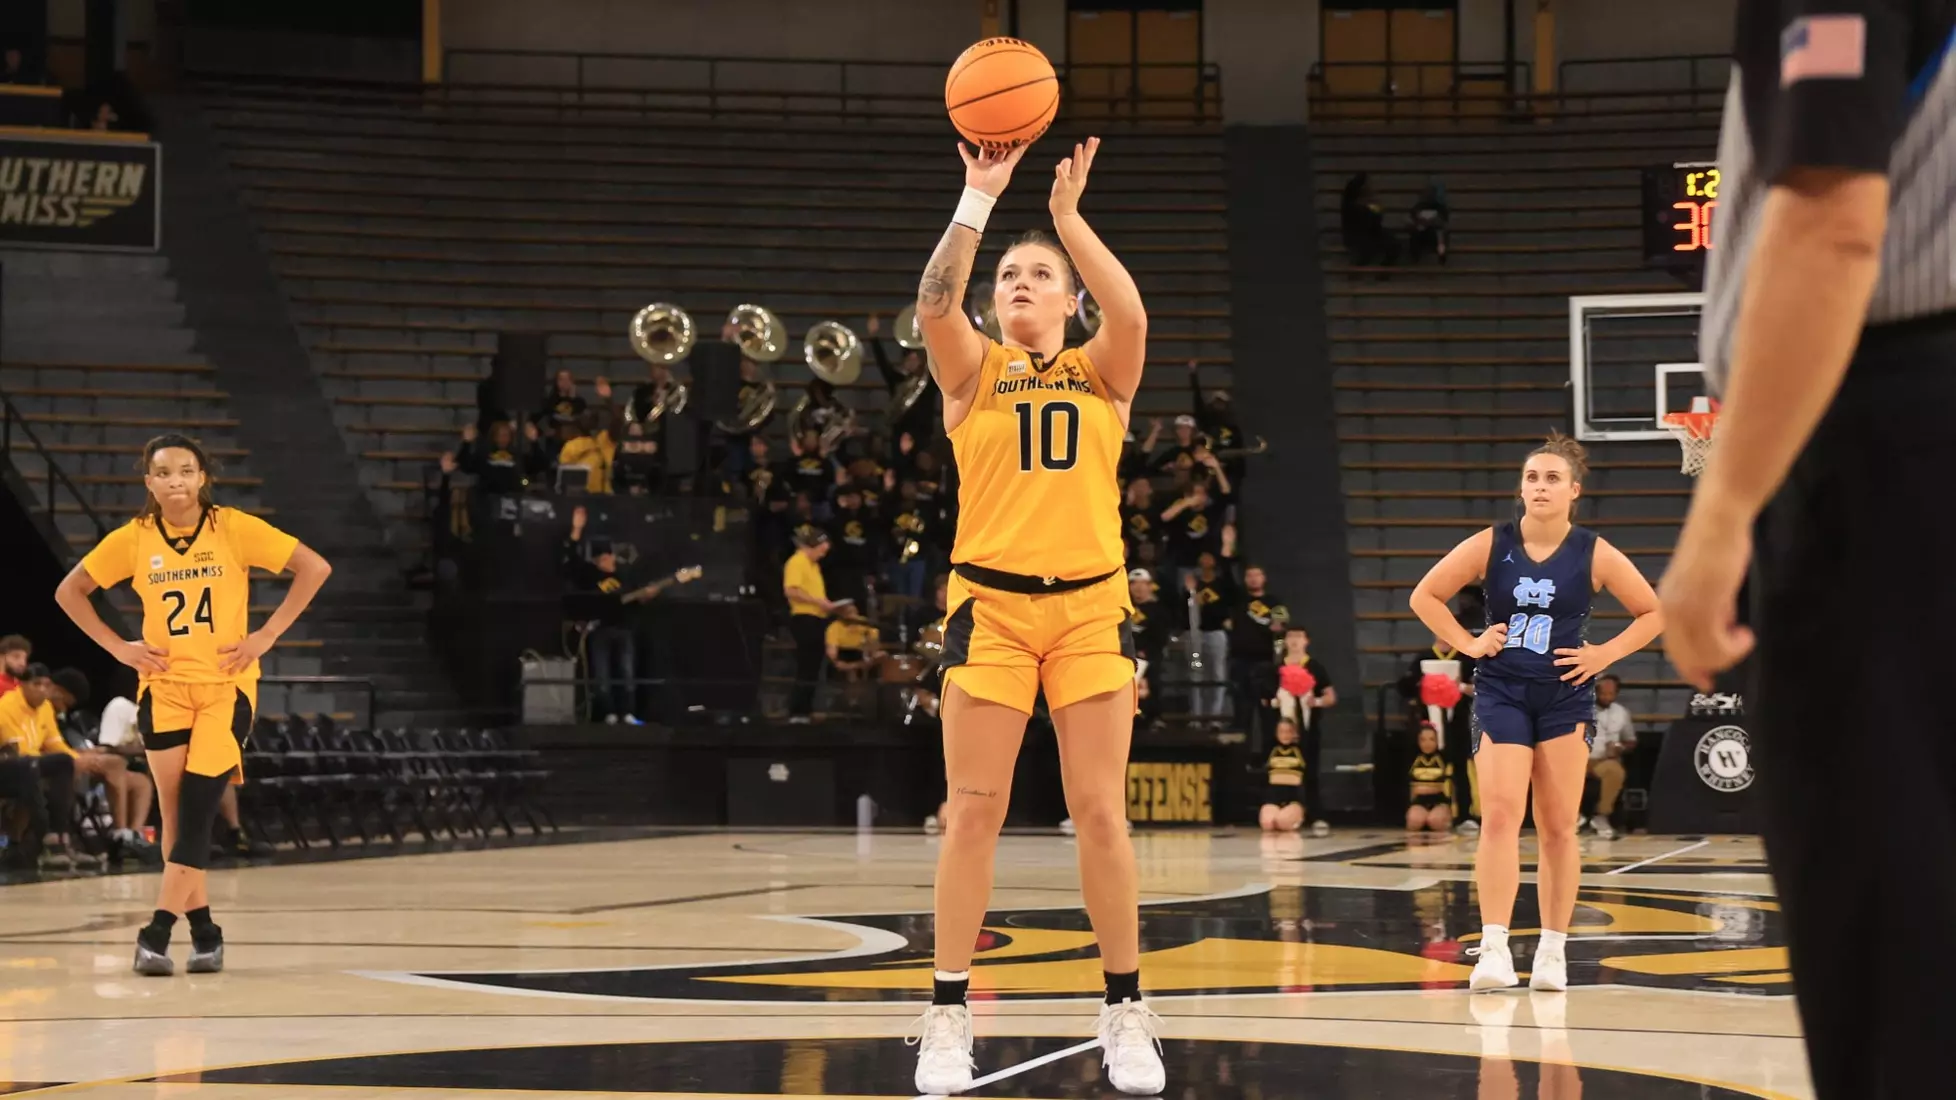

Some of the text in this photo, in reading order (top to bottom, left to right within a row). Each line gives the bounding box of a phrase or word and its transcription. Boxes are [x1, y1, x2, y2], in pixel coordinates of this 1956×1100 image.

[0, 191, 80, 226] MISS
[1014, 400, 1080, 472] 10
[148, 566, 223, 585] SOUTHERN MISS
[161, 586, 215, 637] 24
[1504, 612, 1553, 655] 20
